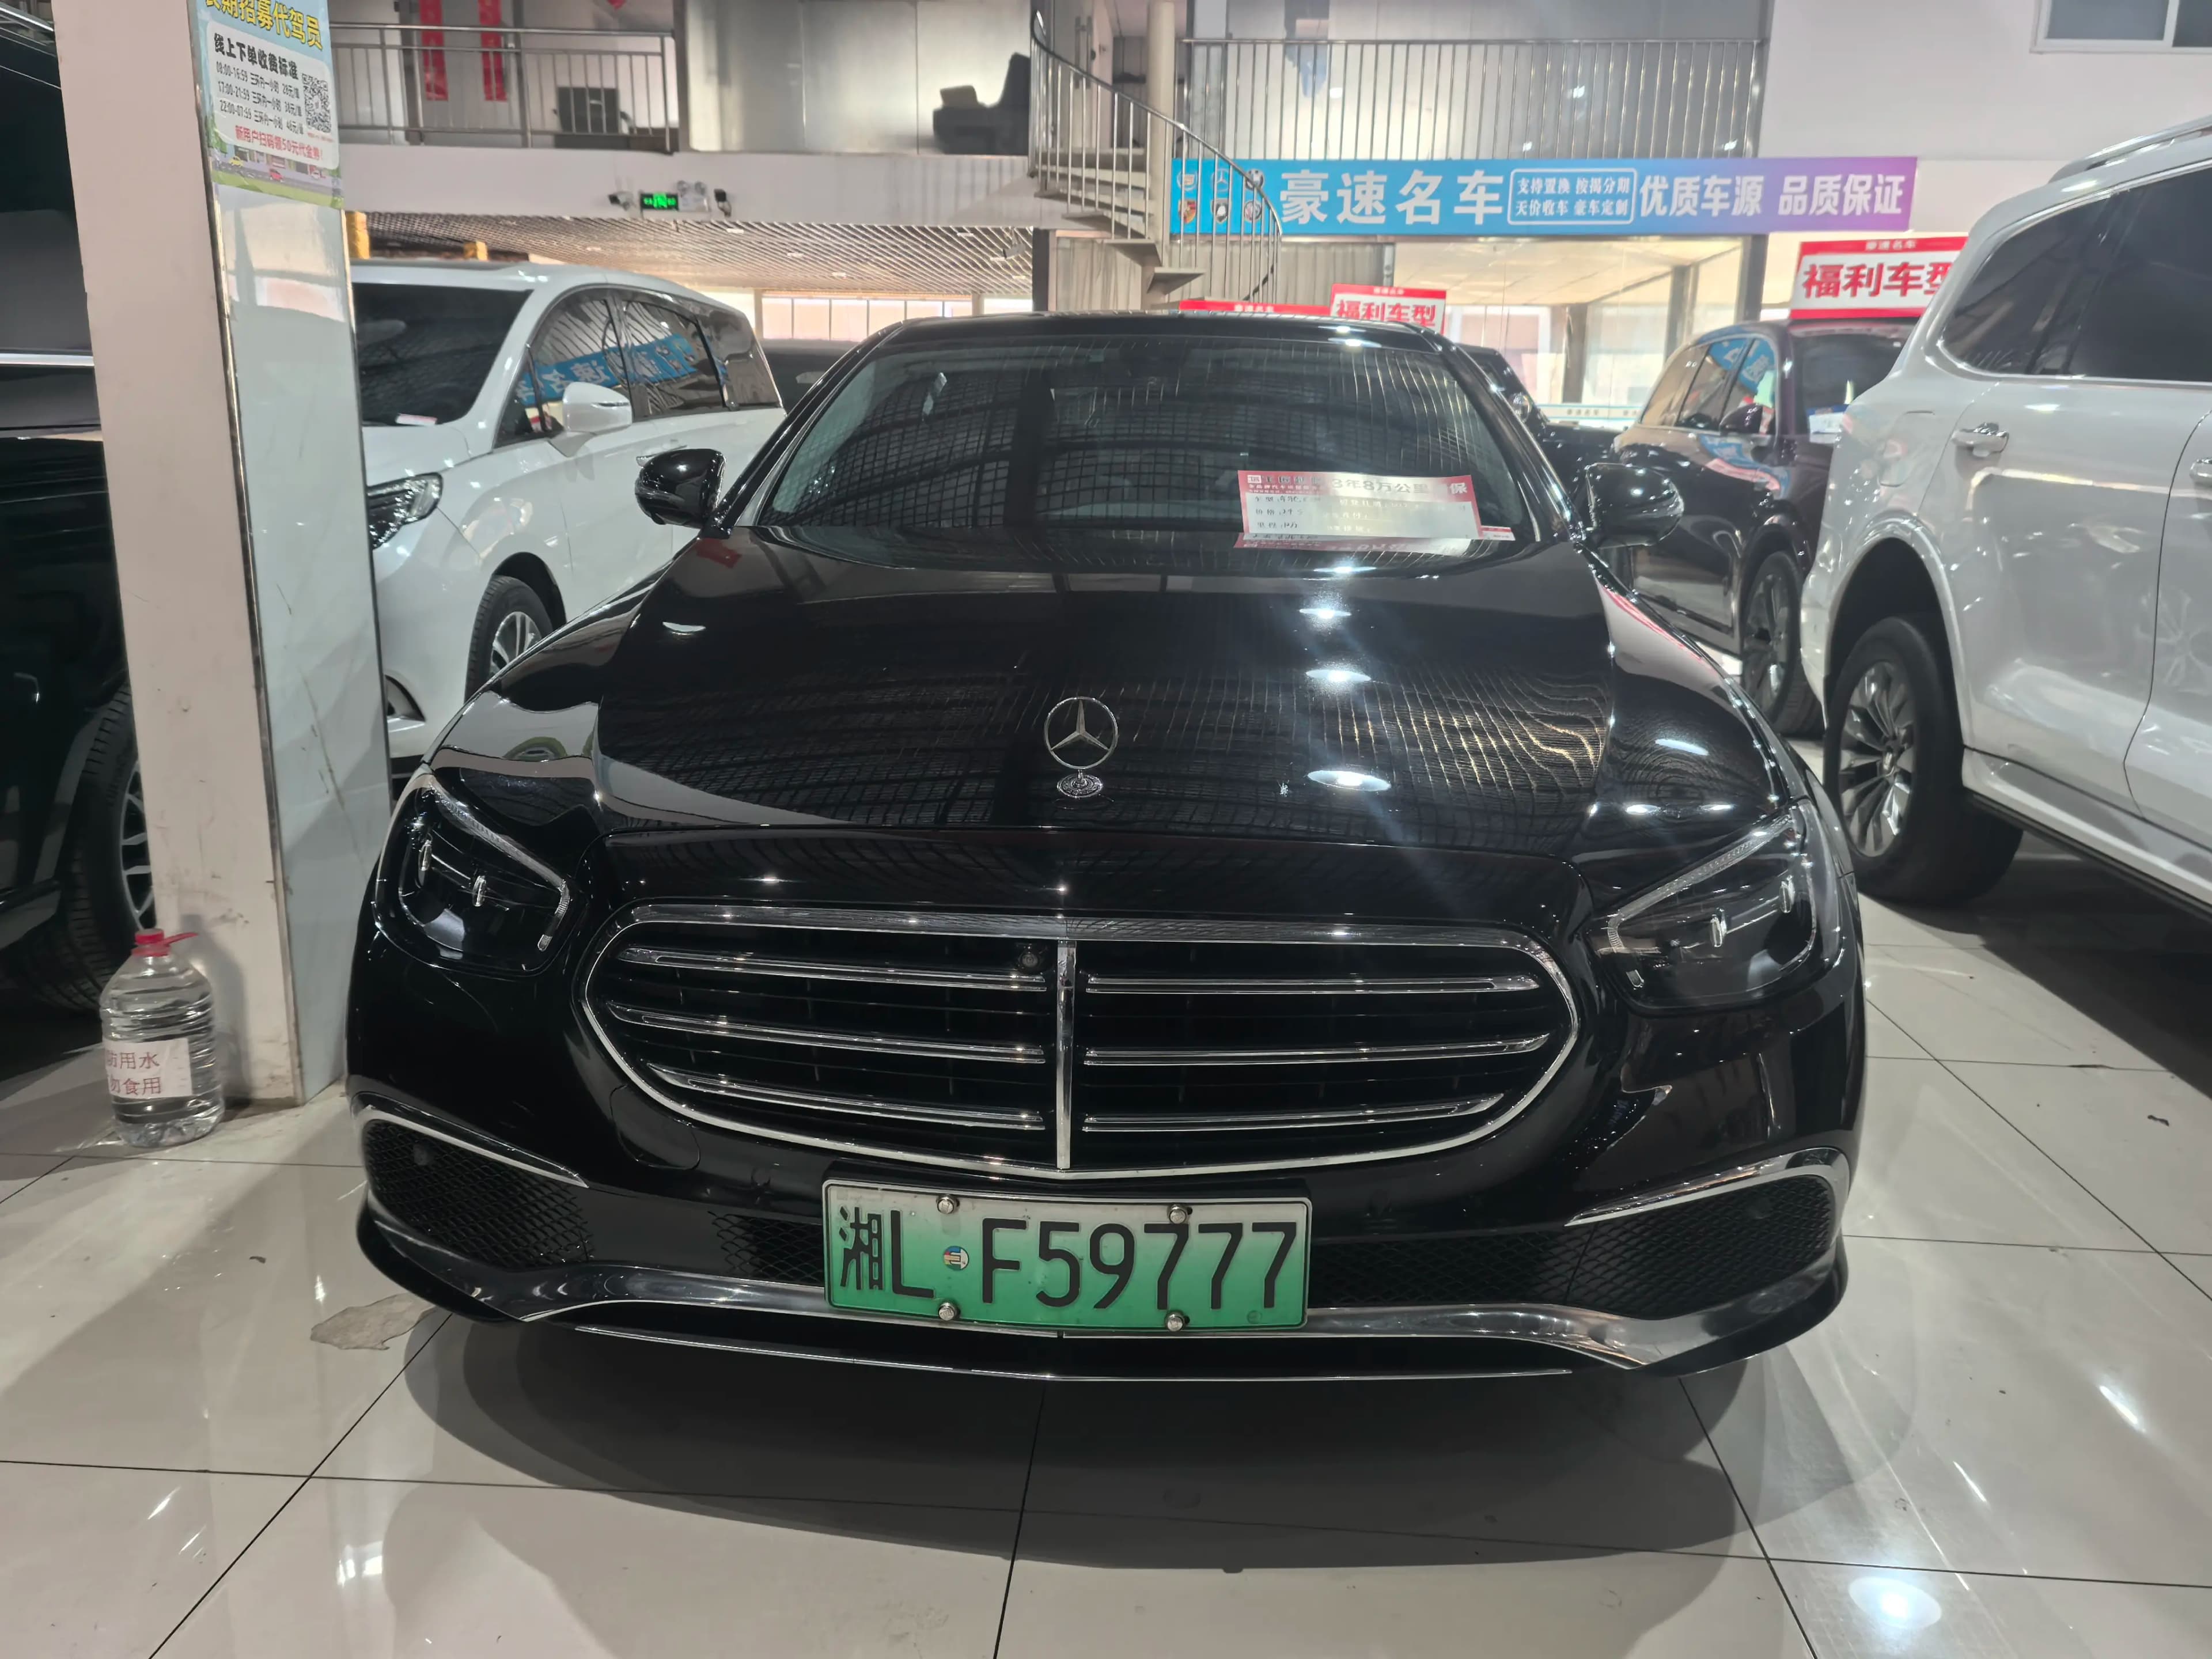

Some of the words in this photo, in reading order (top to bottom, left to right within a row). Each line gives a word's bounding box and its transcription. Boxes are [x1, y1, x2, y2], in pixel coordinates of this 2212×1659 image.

[206, 0, 323, 50] 期招募代驾员
[214, 32, 298, 80] 线上下单收费标准
[1279, 169, 1505, 225] 豪速名车
[1516, 198, 1569, 217] 天价收车
[1517, 176, 1570, 195] 支持置换
[1575, 176, 1630, 195] 按揭分期
[1639, 175, 1764, 218] 优质车源
[1778, 173, 1906, 216] 品质保证
[1335, 298, 1437, 328] 福利车型
[982, 1217, 1298, 1310] F59777
